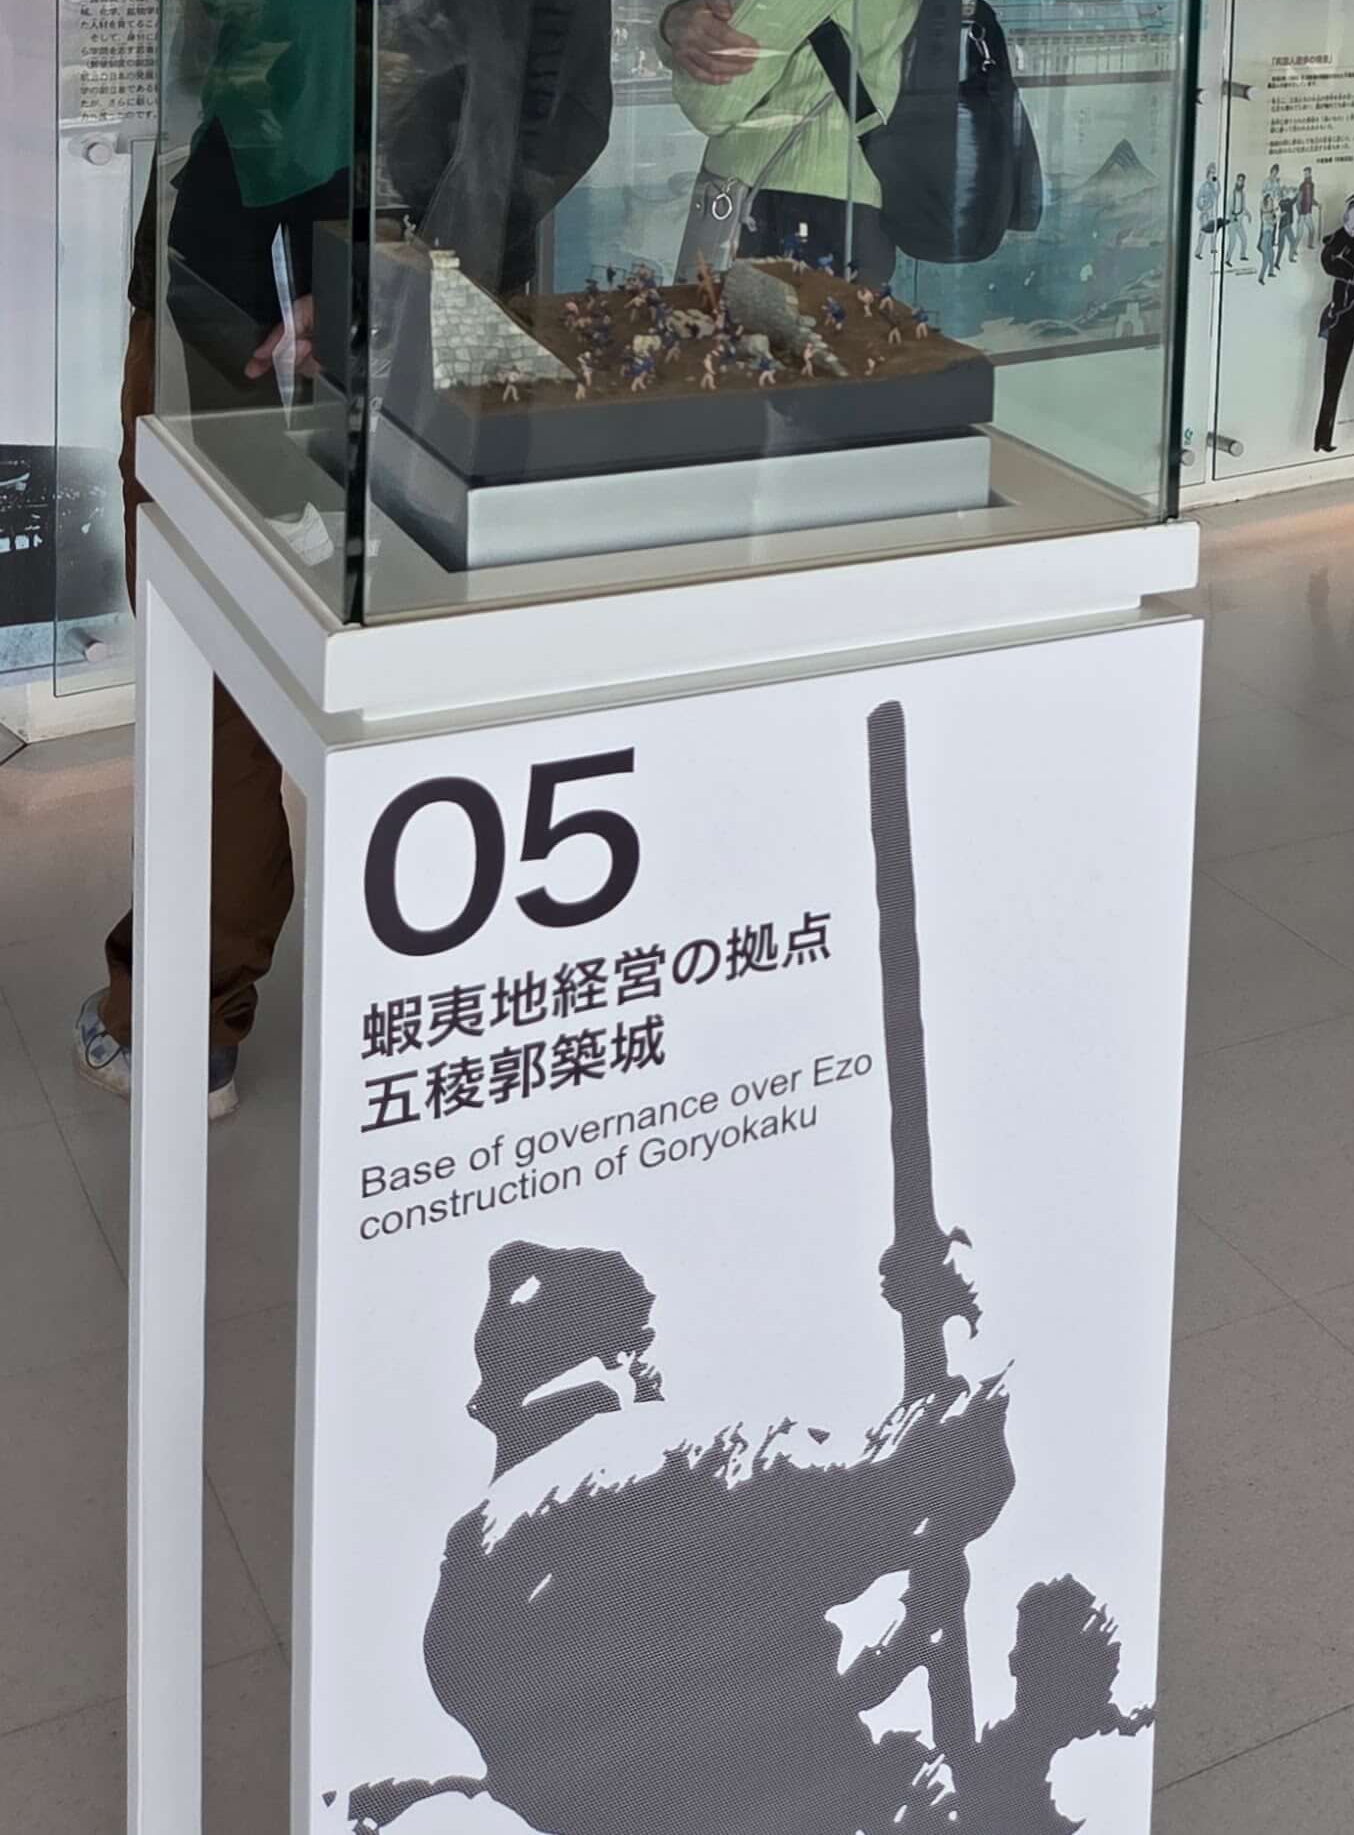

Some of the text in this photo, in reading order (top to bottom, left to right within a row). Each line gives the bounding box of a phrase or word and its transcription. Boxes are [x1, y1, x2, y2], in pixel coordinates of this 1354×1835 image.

[363, 746, 641, 958] 05
[360, 911, 832, 1060] 蝦夷地経営の拠点
[360, 1014, 668, 1135] 五稜郭築城
[361, 1048, 874, 1199] Base of governance over Ezo
[358, 1102, 818, 1241] construction of Goryokaku
